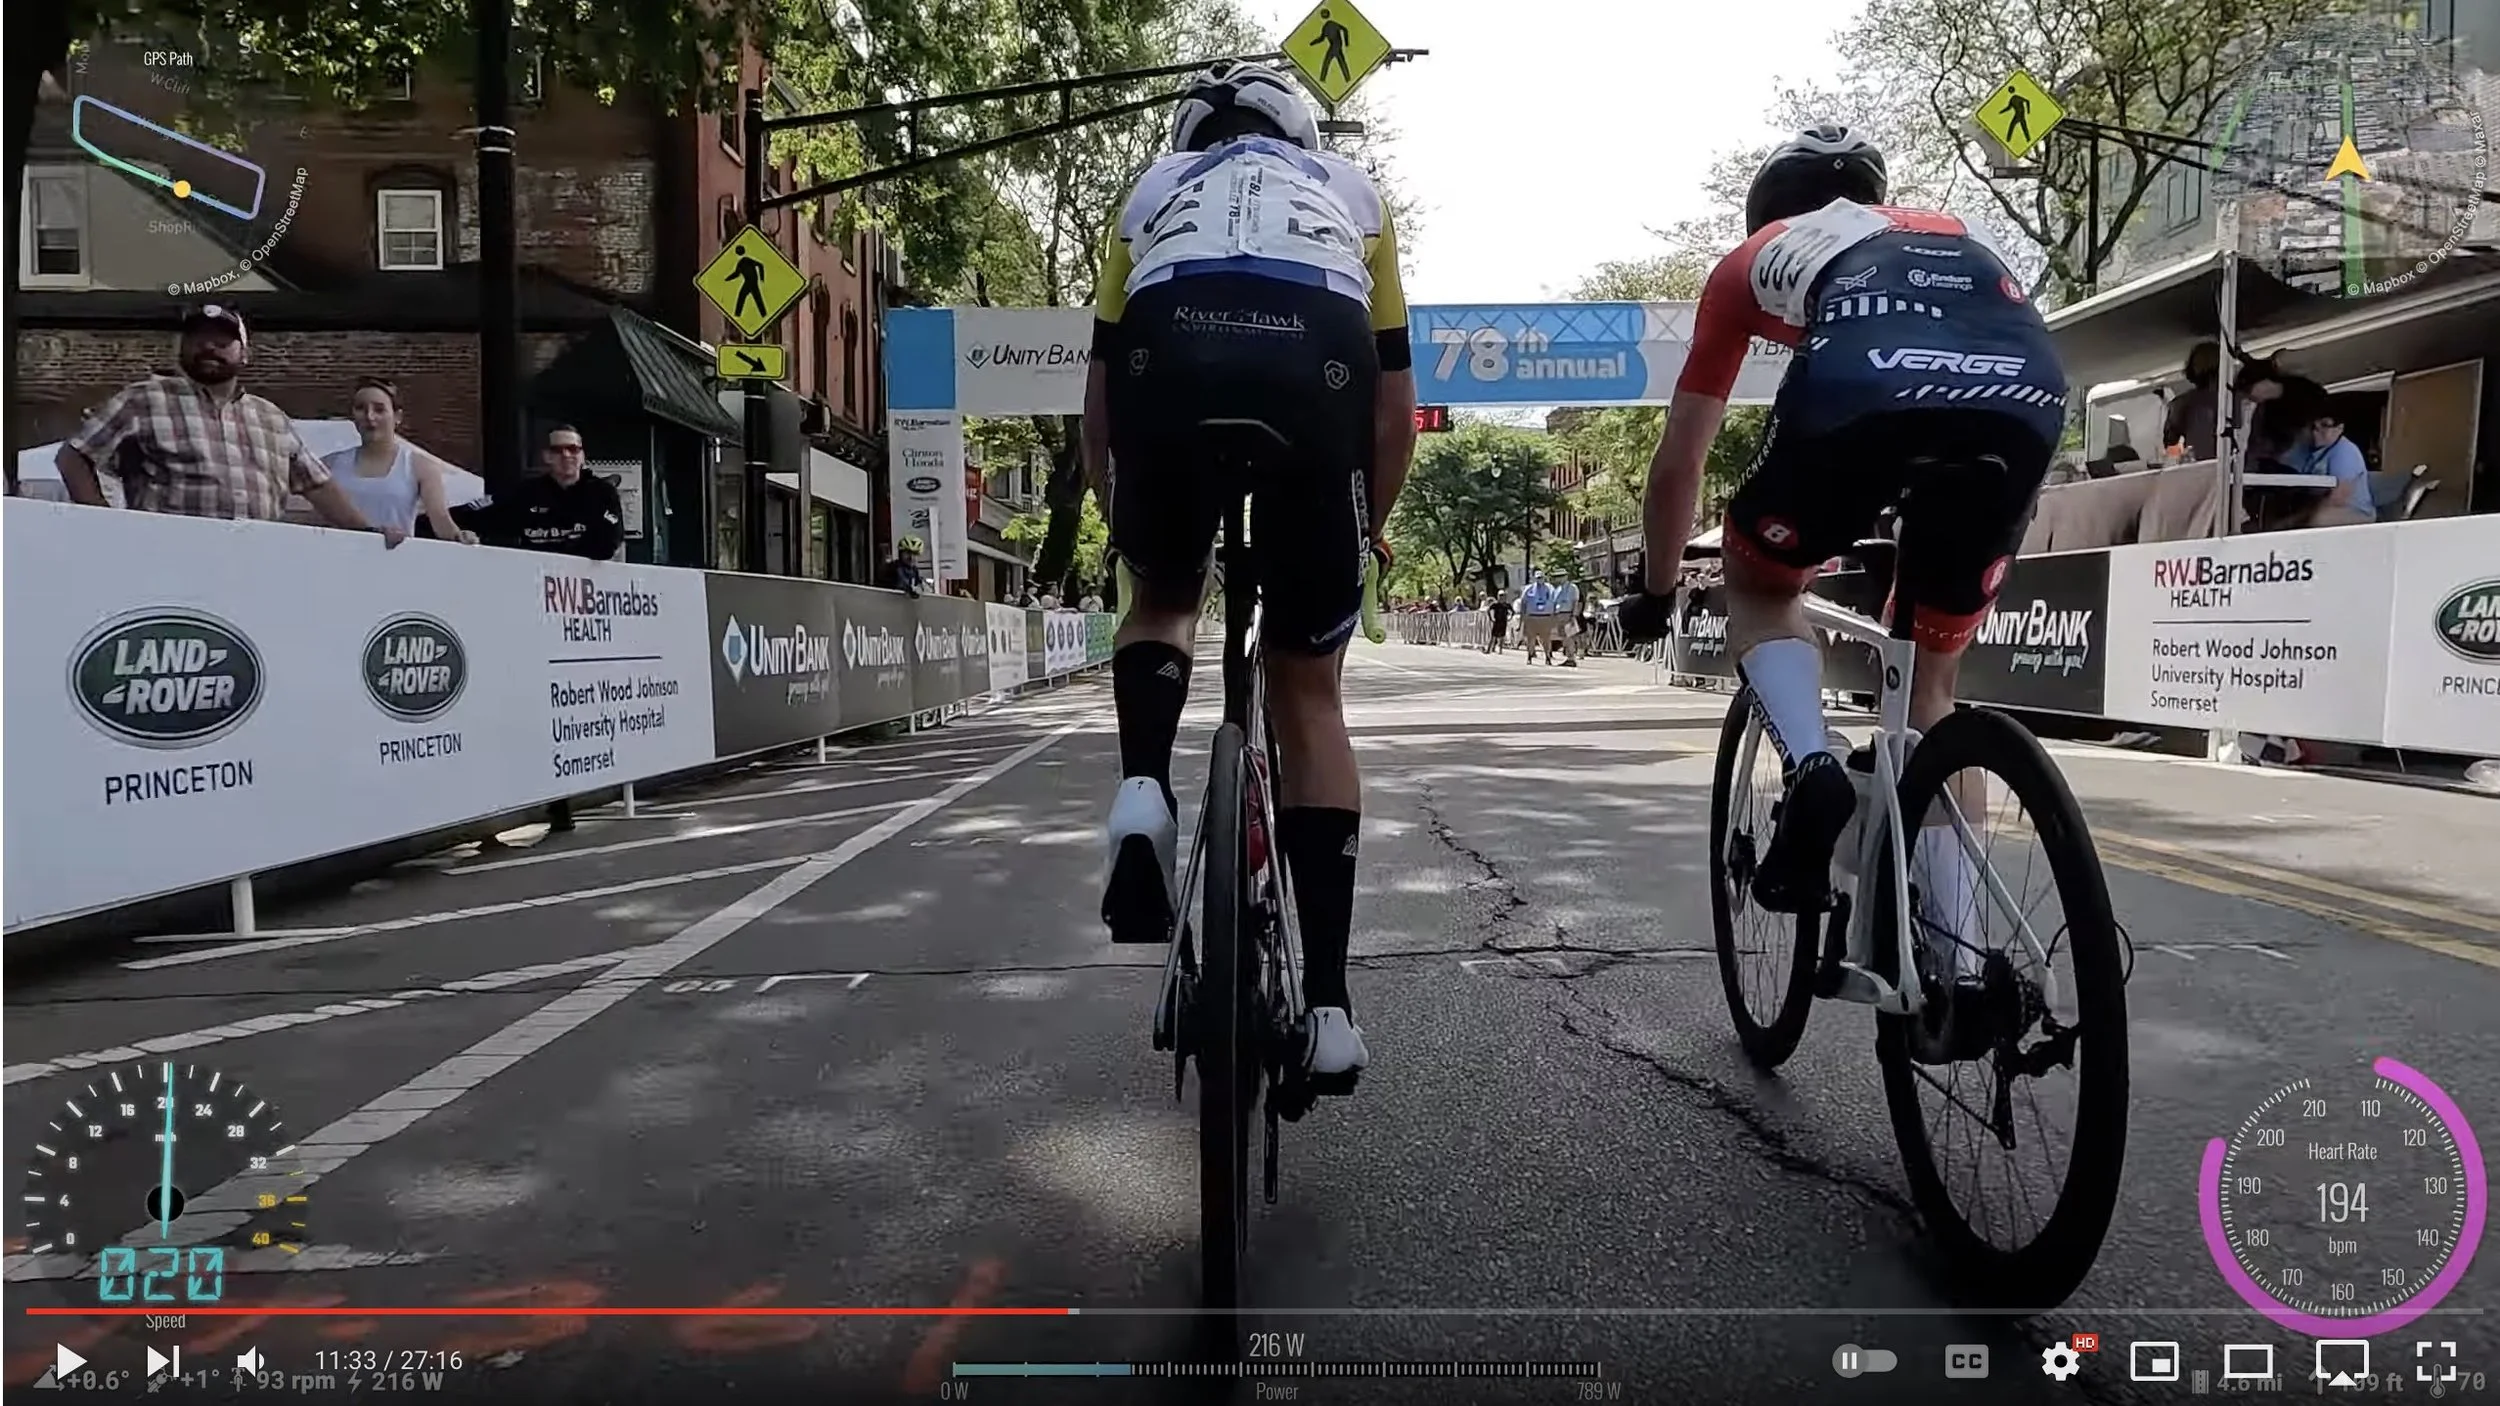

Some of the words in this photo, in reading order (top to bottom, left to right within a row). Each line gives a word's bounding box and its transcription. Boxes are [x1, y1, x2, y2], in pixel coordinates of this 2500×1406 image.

[1431, 327, 1510, 383] 78
[1516, 351, 1627, 381] annual
[1867, 347, 2027, 378] VERGE
[2154, 550, 2313, 588] RWJBarnabas
[545, 575, 659, 617] RWJBarnabas
[2170, 587, 2232, 608] HEALTH
[563, 617, 612, 642] HEALTH
[113, 638, 208, 676] LAND
[383, 636, 435, 665] LAND
[2152, 638, 2201, 658] Robert
[2206, 637, 2254, 660] Wood
[2260, 637, 2337, 661] Johnson
[389, 665, 452, 696] ROVER
[550, 680, 595, 708] Robert
[598, 676, 633, 702] Wood
[636, 674, 679, 700] Johnson
[2151, 664, 2225, 692] University
[2230, 667, 2304, 694] Hospital
[2442, 676, 2500, 695] PRINC
[125, 675, 236, 716] ROVER
[2151, 691, 2219, 713] Somerset
[552, 709, 616, 743] University
[619, 704, 666, 735] Hospital
[380, 733, 462, 766] PRINCETON
[554, 748, 615, 778] Somerset
[105, 759, 254, 805] PRINCETON
